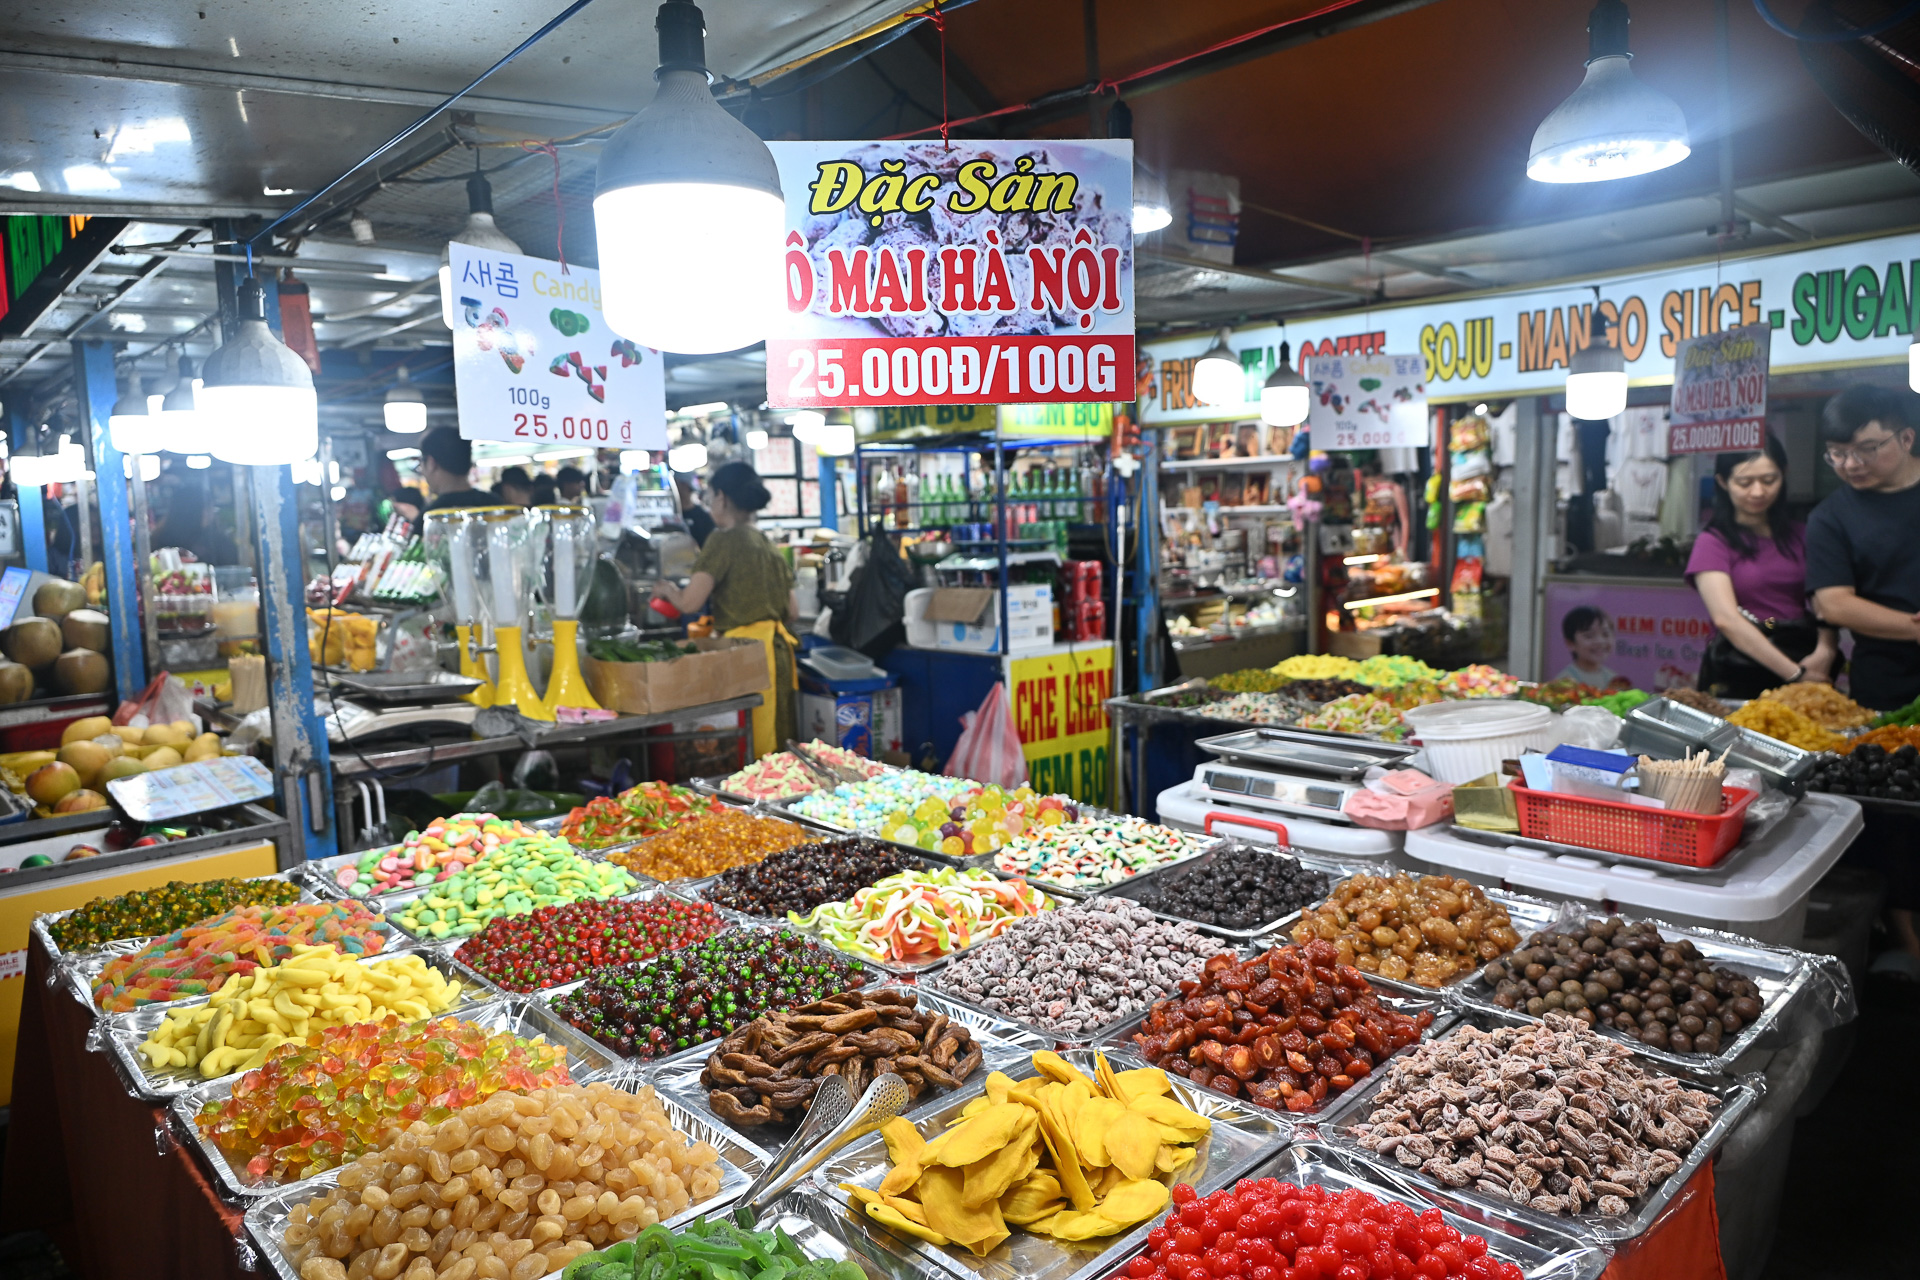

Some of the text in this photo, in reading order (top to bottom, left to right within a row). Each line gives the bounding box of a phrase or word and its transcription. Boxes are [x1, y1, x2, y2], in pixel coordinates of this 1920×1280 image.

[808, 155, 1079, 227] Đặc Sản
[463, 260, 603, 311] 새콤 Candy
[785, 228, 1121, 328] Ô MAI HÀ NỘI
[787, 343, 1116, 398] 25.000Đ/100G
[1420, 316, 1494, 383] SOJU
[508, 387, 550, 410] 100g
[1617, 616, 1655, 634] KEM
[1016, 657, 1112, 745] CHÈ LIÊN
